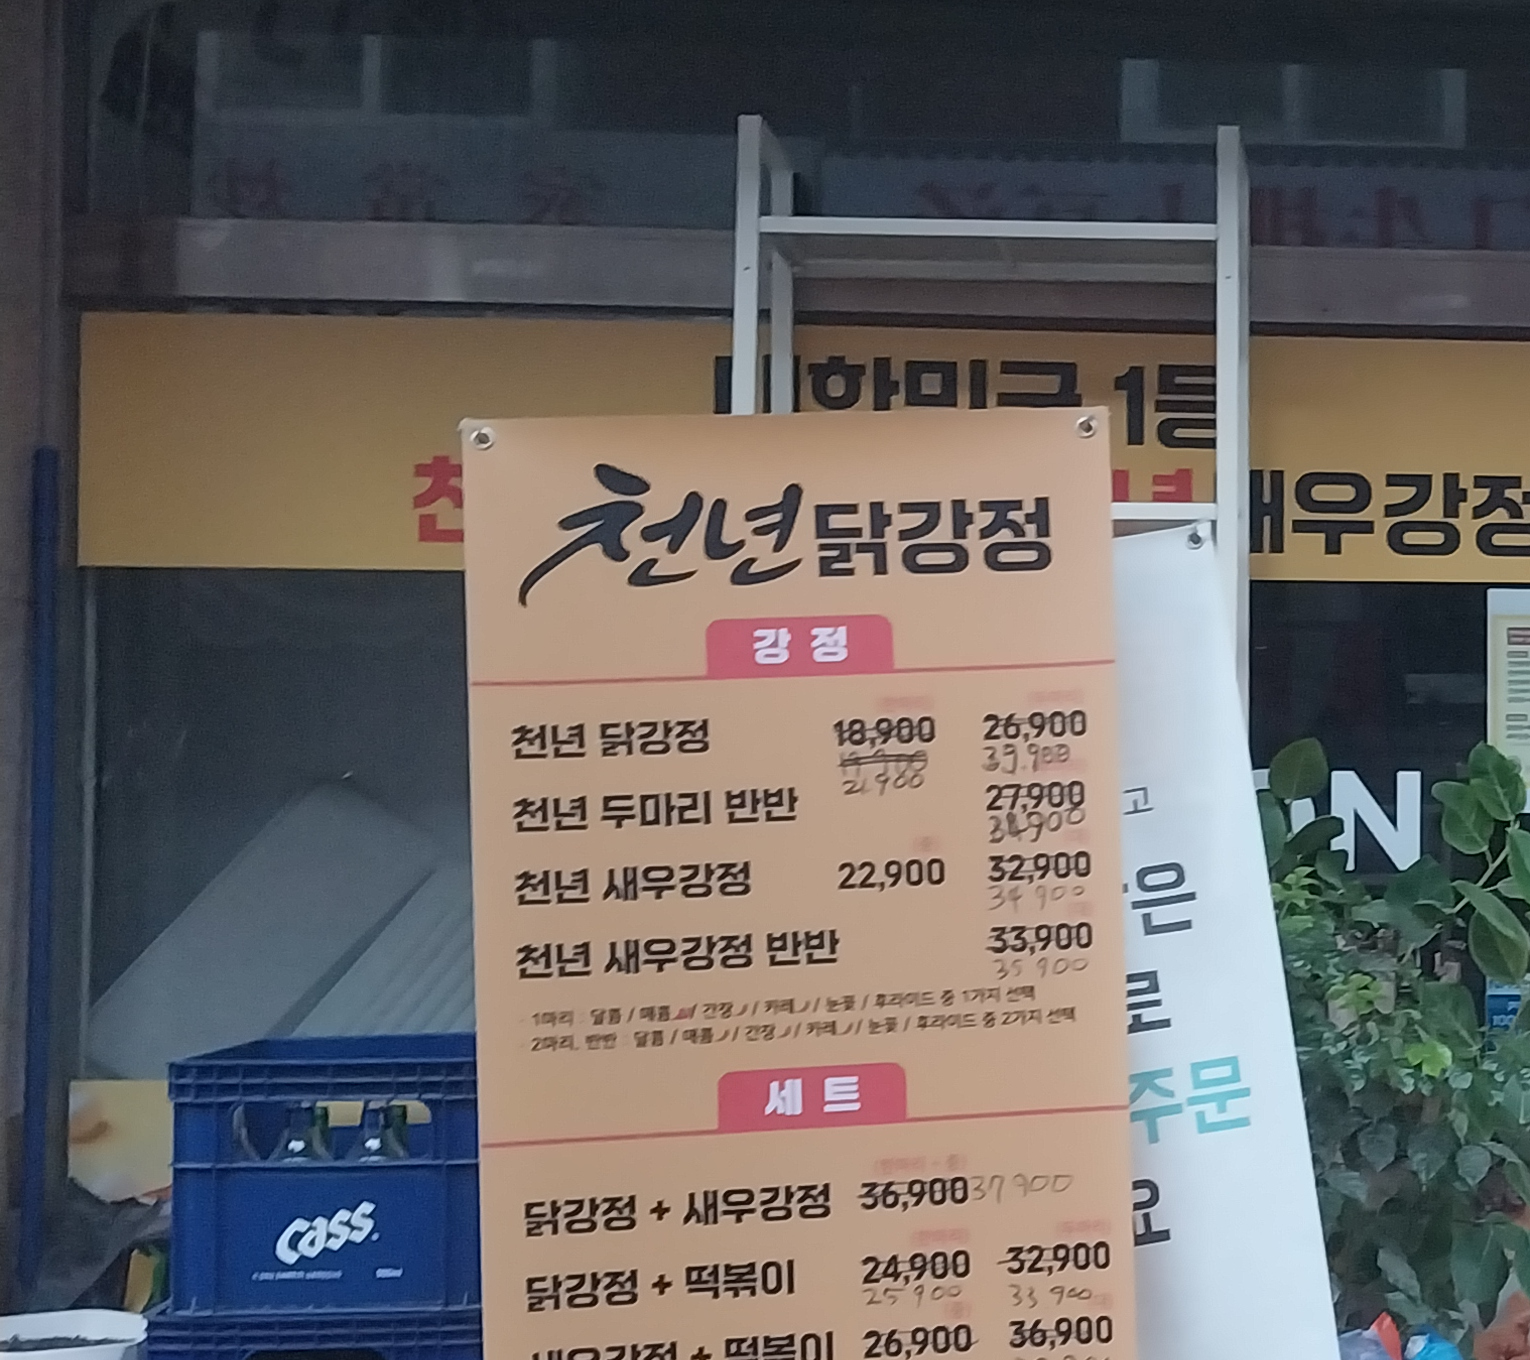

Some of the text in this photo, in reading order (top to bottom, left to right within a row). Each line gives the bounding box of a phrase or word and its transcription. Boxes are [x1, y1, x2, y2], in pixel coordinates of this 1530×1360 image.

[511, 723, 586, 759] 천년
[599, 718, 710, 757] 닭강정
[982, 709, 1087, 742] 26,900
[513, 780, 1086, 832] 천년 두마리 반반 27,900
[515, 850, 1091, 906] 천년 새우강정 22,900 32,900
[516, 922, 1093, 979] 천년 새우강정 반반 33,900
[275, 1200, 379, 1266] Cass
[524, 1194, 637, 1238] 닭강정
[683, 1182, 831, 1226] 새우강정
[857, 1176, 969, 1213] 36,900
[525, 1268, 638, 1313] 닭강정
[685, 1258, 796, 1301] 떡볶이
[861, 1249, 970, 1285] 24,900
[1003, 1240, 1111, 1278] 32,900
[863, 1323, 973, 1360] 26,900
[1009, 1315, 1113, 1352] 36,900
